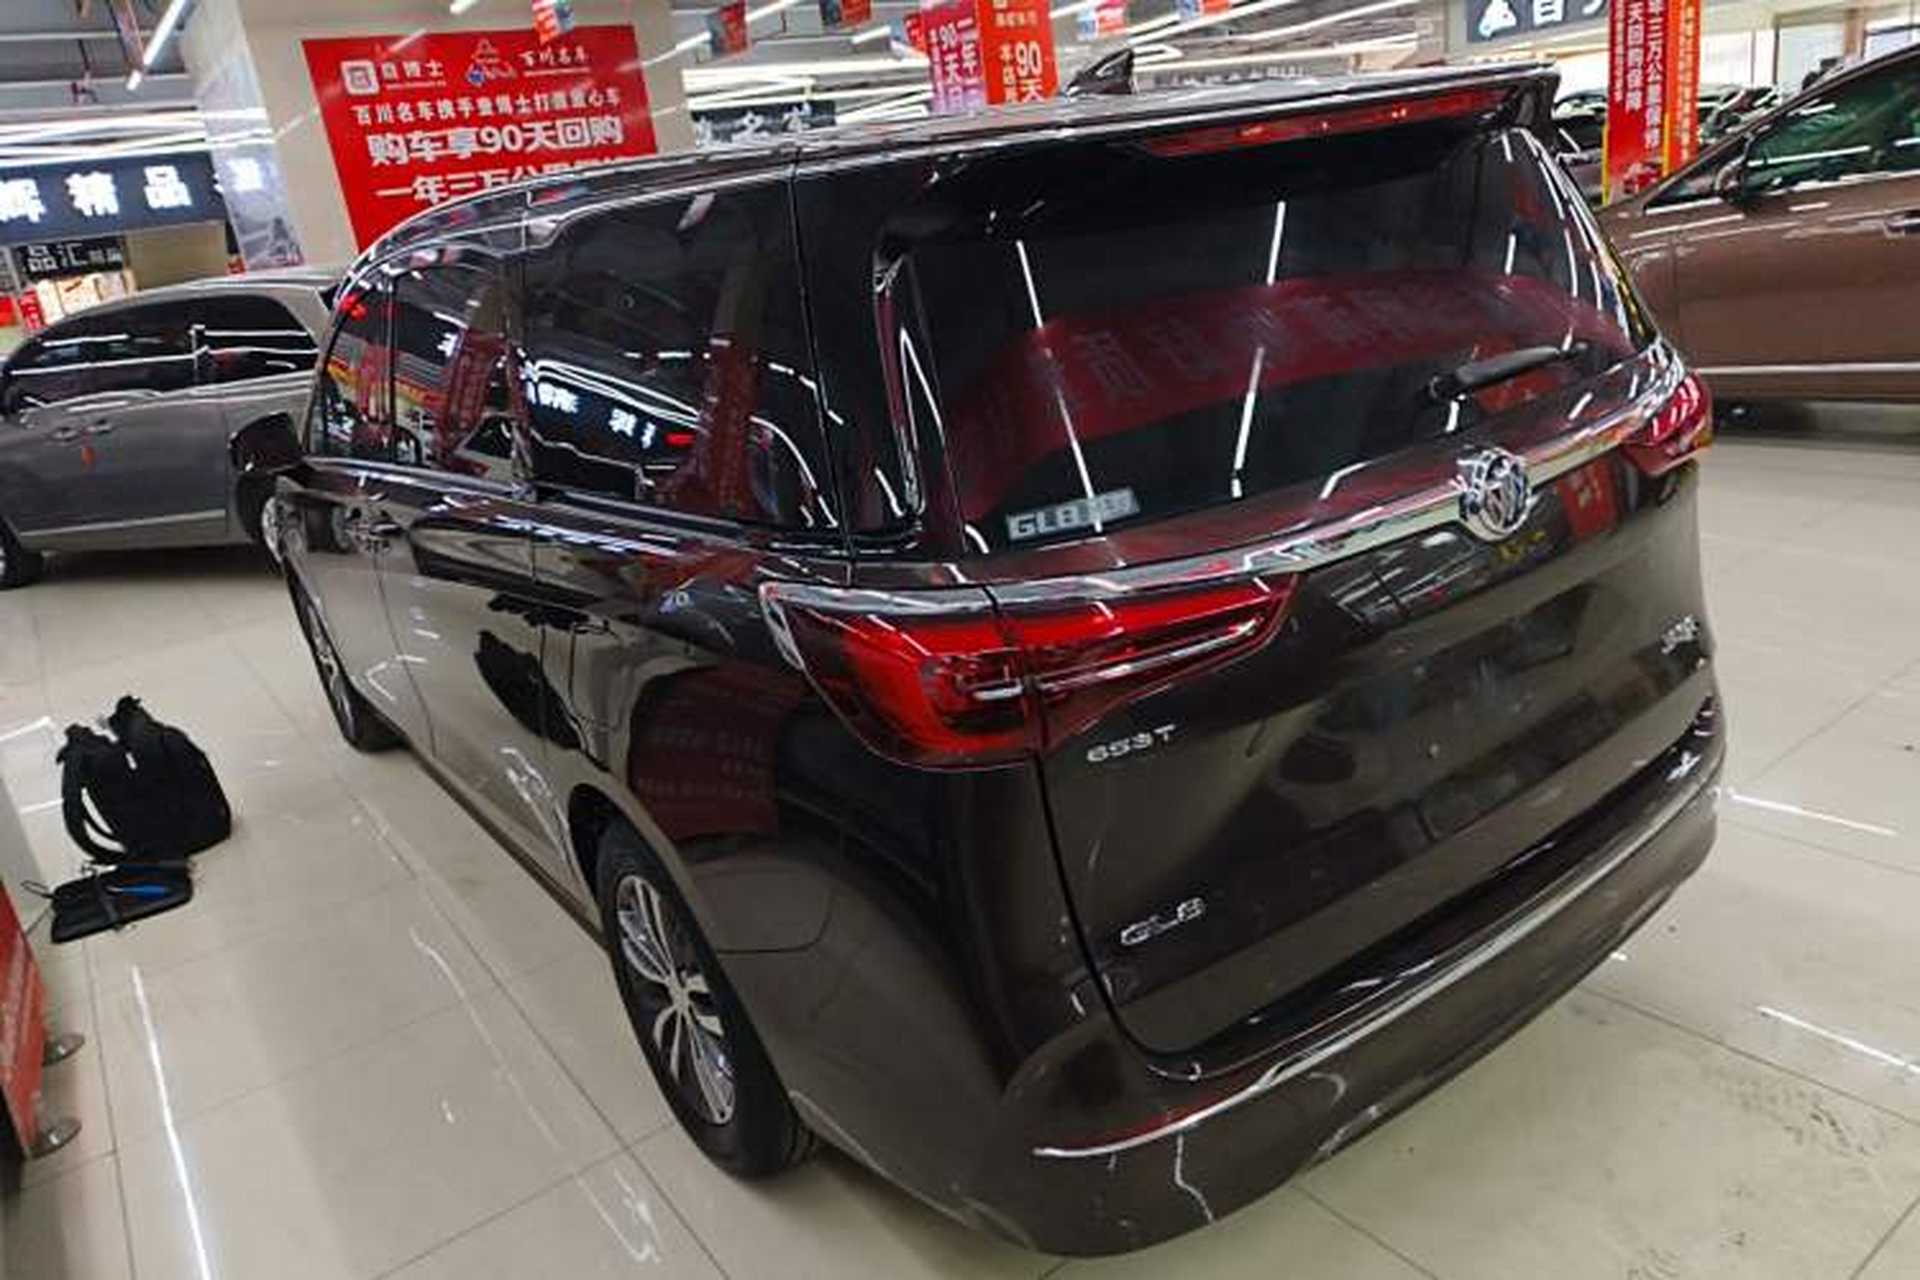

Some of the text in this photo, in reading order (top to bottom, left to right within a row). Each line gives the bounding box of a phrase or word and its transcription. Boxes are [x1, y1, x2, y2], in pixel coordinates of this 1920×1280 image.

[366, 115, 624, 166] 购车享90天回购
